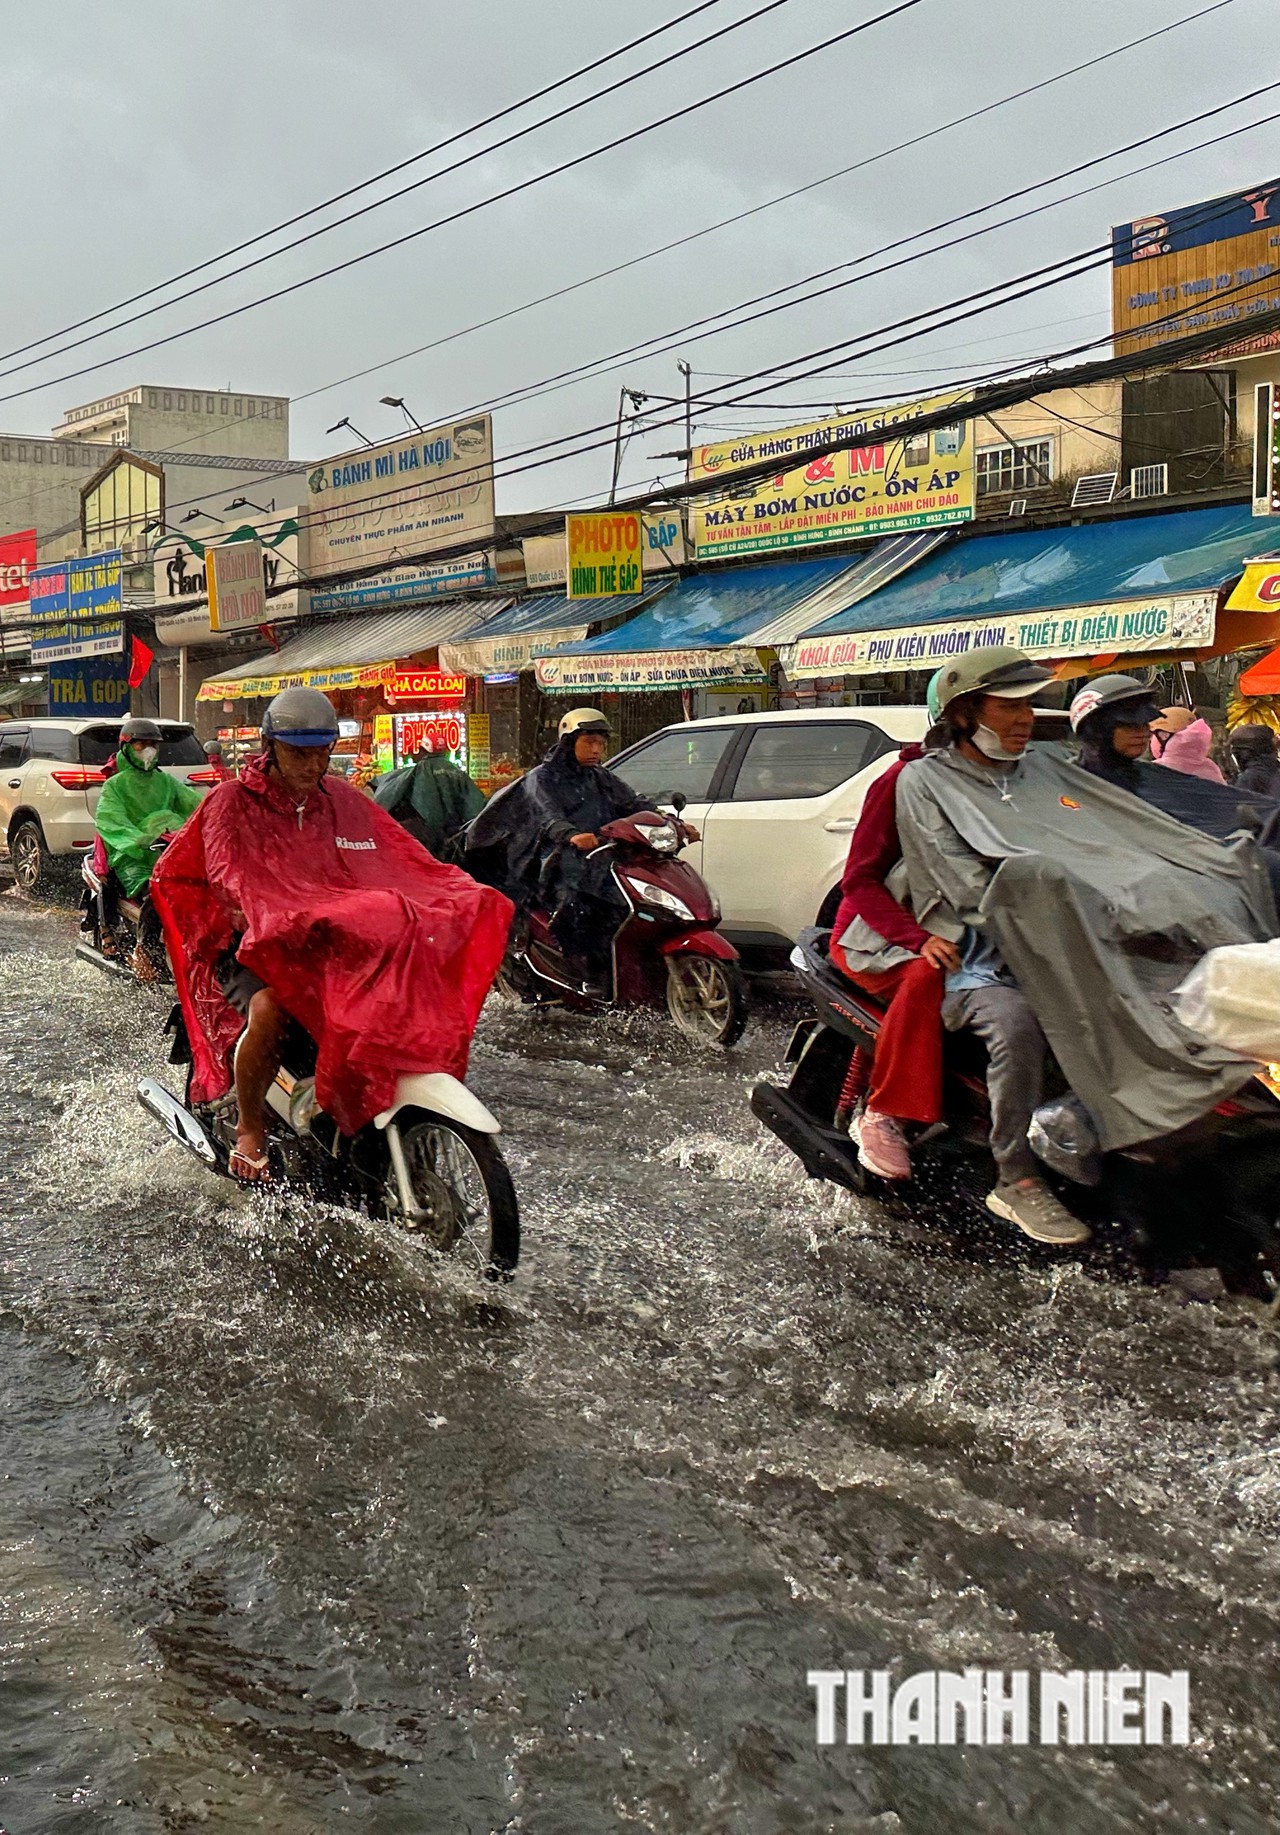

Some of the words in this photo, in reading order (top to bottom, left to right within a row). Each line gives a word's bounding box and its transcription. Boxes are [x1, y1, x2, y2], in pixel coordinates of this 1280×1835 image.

[332, 458, 372, 489] BÁNH
[375, 450, 395, 478] MÌ
[398, 444, 419, 473] HÀ
[423, 437, 452, 468] NỘI
[731, 443, 755, 463] CỬA
[759, 437, 792, 457] HÀNG
[754, 498, 798, 519] BƠM
[804, 485, 866, 511] NƯỚC
[926, 469, 960, 491] ÁP
[329, 533, 362, 547] CHUYÊN
[364, 529, 385, 543] THỰC
[431, 512, 464, 527] NHANH
[754, 522, 771, 535] TÂM
[887, 498, 914, 514] HÀNH
[916, 496, 936, 509] CHU
[939, 492, 959, 507] ĐÁO
[571, 516, 638, 554] PHOTO
[572, 561, 597, 595] HÌNH
[599, 556, 617, 592] THẺ
[619, 554, 638, 592] GẤP
[831, 637, 857, 667] CỬA
[868, 639, 895, 668] PHỤ
[896, 633, 927, 665] KIỆN
[928, 628, 970, 657] NHÔM
[1019, 615, 1059, 648] THIẾT
[1061, 620, 1077, 650] BỊ
[1080, 611, 1118, 646] ĐIỆN
[1121, 606, 1168, 640] NƯỚC
[51, 671, 87, 703] TRẢ
[92, 674, 129, 703] GÓP
[413, 676, 436, 691] CÁC
[438, 677, 463, 692] LOẠI
[335, 836, 377, 850] Rinnai
